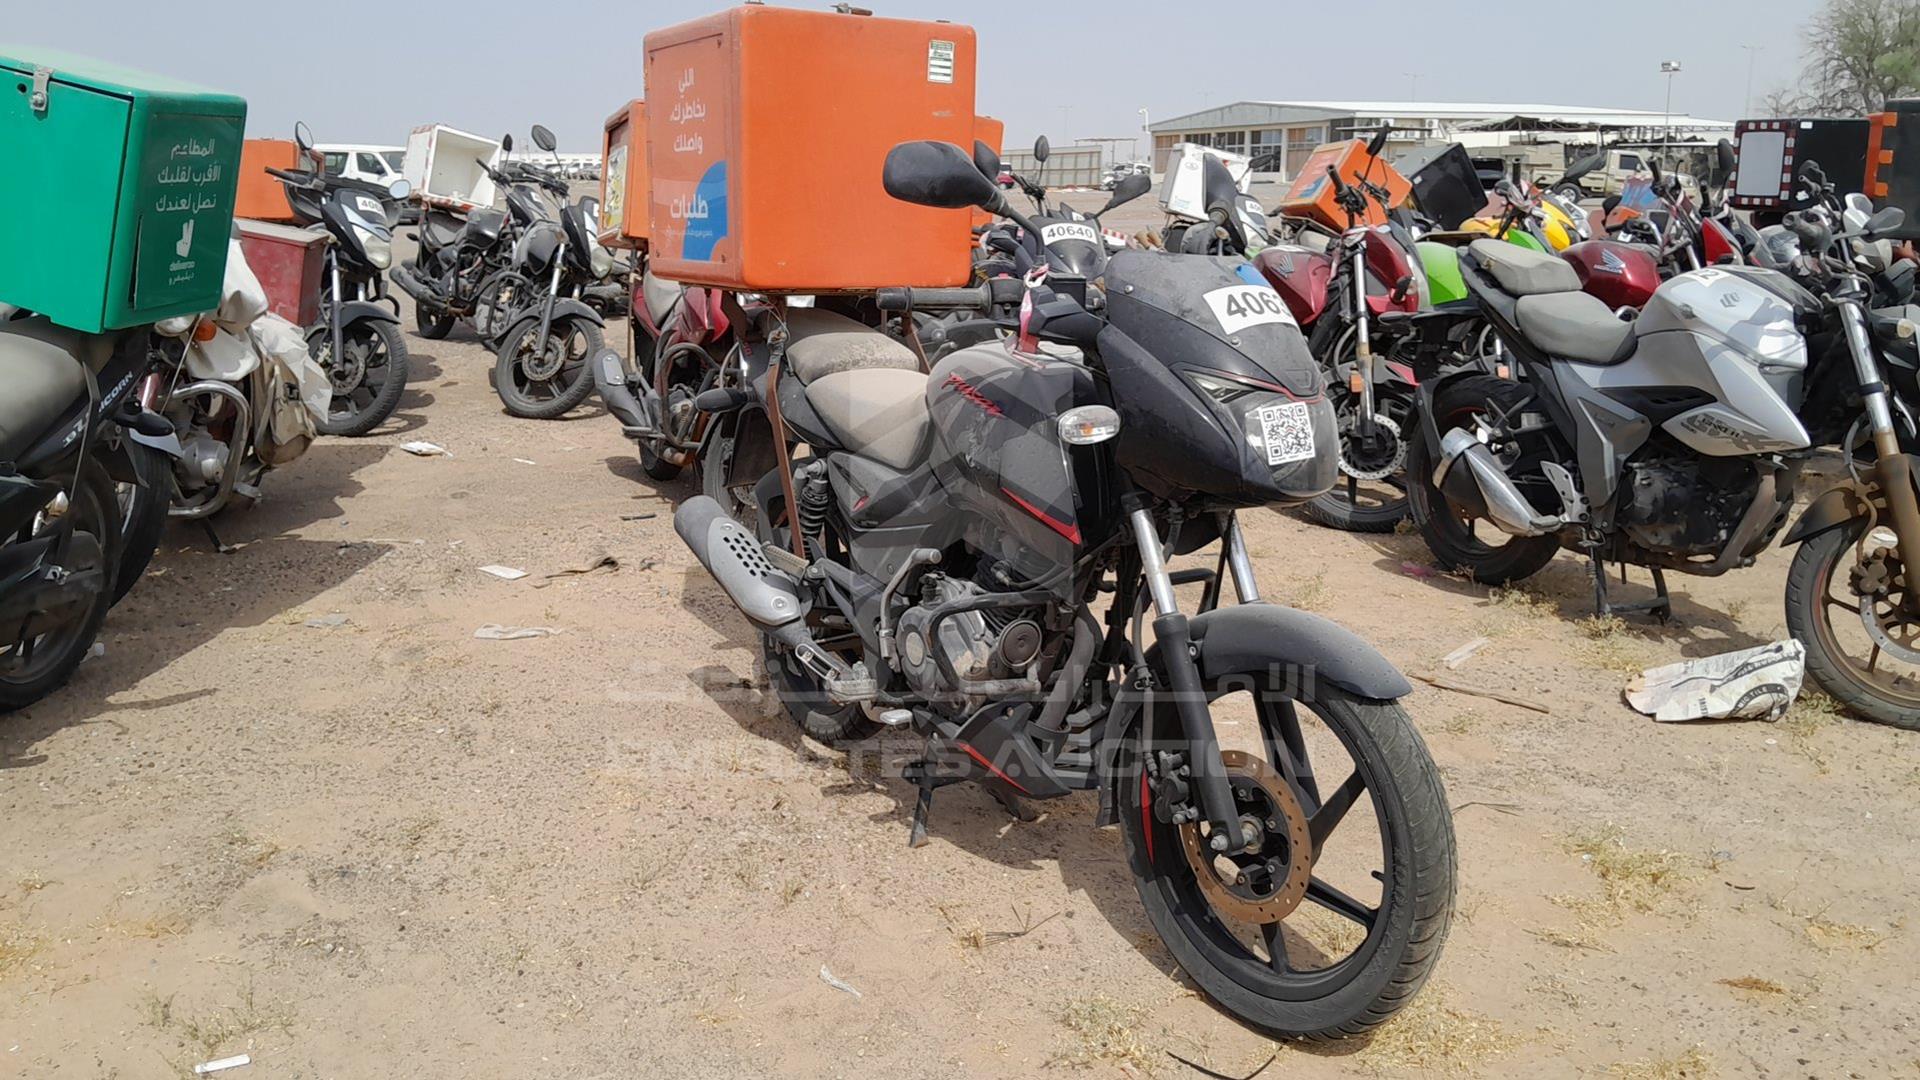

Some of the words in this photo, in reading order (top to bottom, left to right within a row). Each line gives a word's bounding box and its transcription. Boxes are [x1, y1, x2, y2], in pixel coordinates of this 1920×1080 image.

[678, 67, 695, 99] اللي
[170, 137, 216, 161] المطاعم
[673, 132, 704, 155] واصلك
[157, 166, 192, 187] لقلبك
[155, 193, 192, 212] لعندك
[670, 193, 709, 226] طلبات
[1047, 225, 1094, 239] 40640
